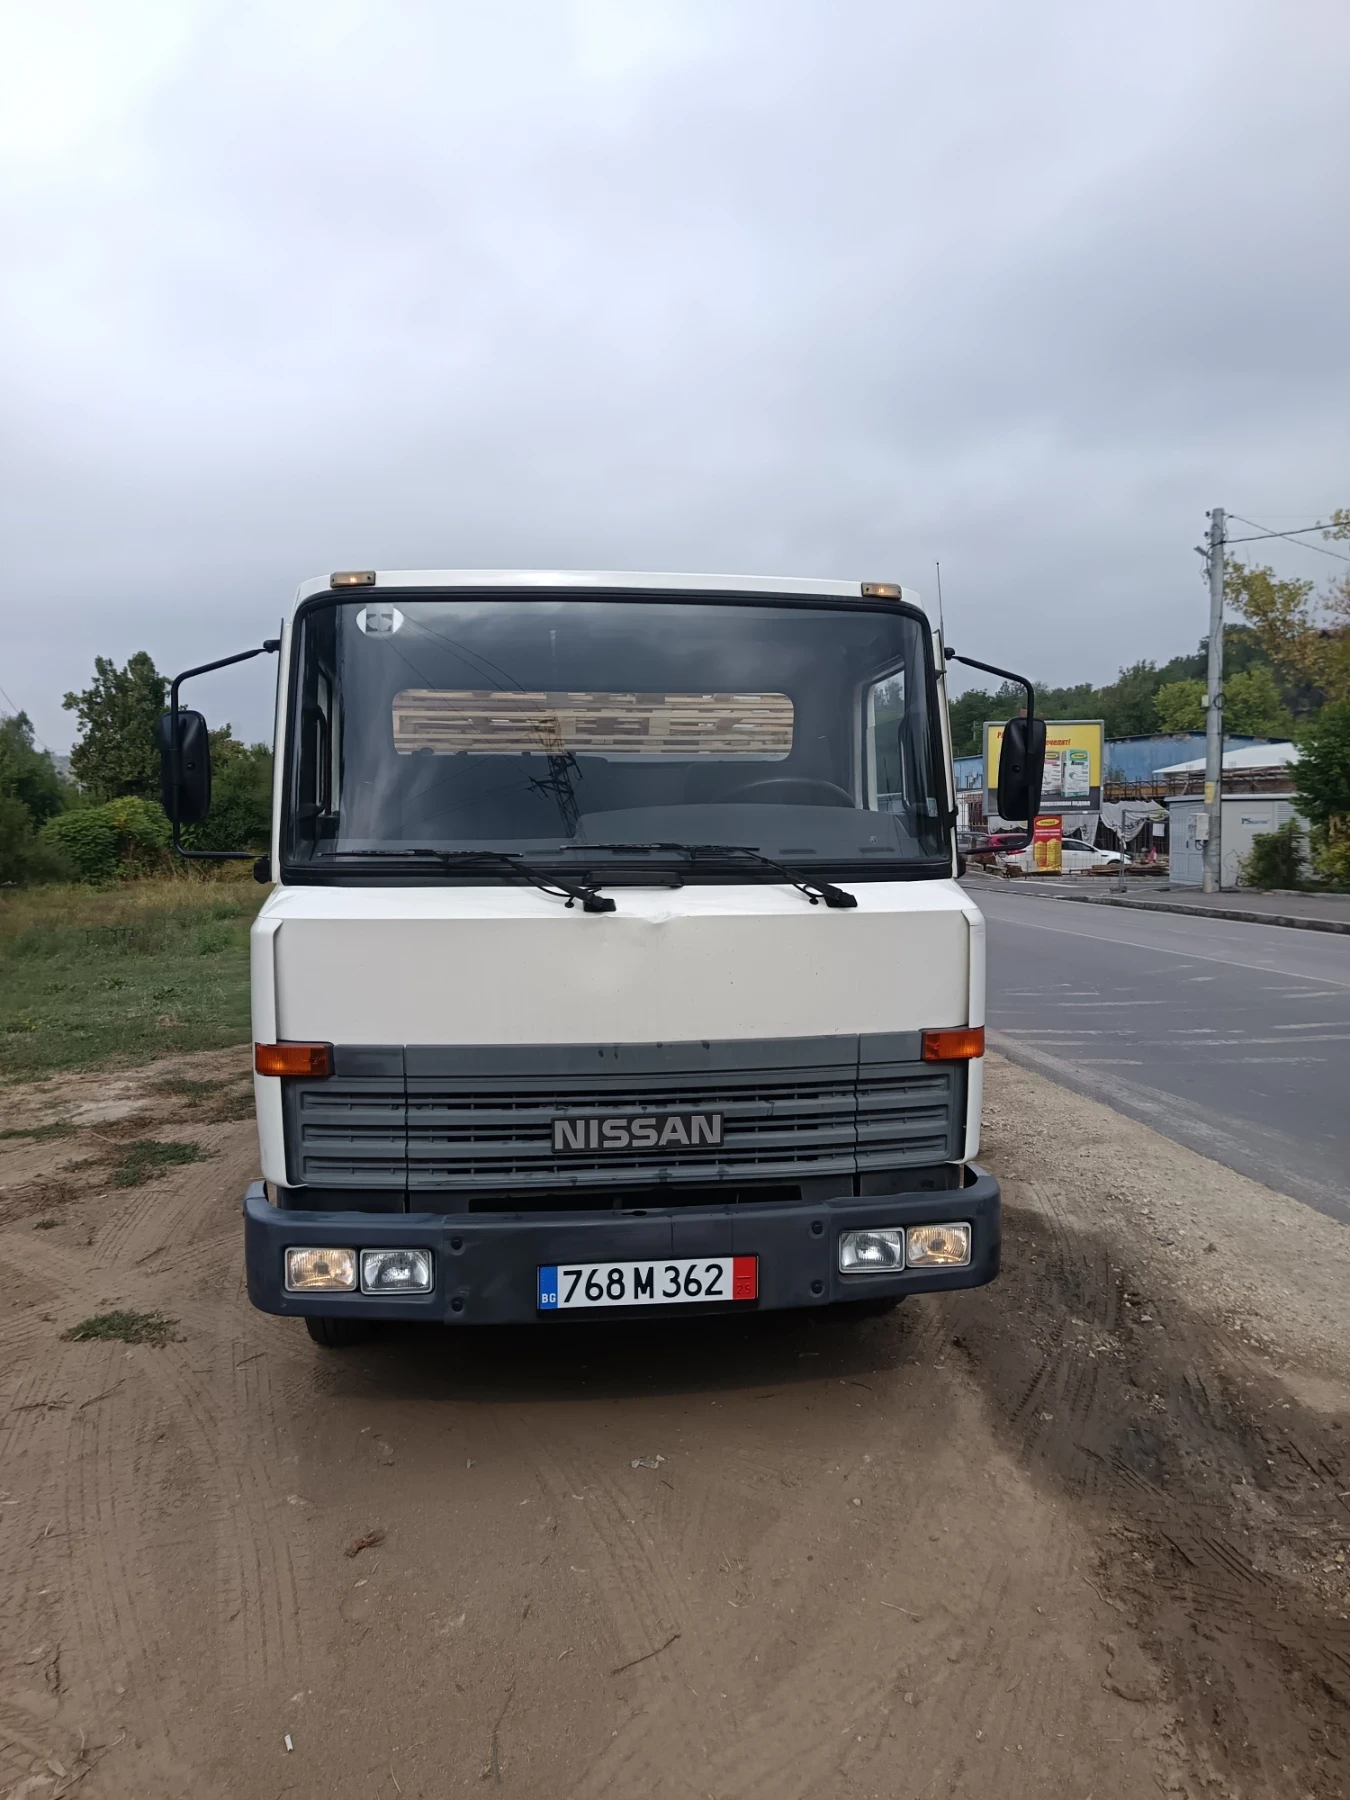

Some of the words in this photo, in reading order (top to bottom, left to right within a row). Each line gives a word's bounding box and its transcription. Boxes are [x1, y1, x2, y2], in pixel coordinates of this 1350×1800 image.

[554, 1114, 721, 1150] NISSAN
[563, 1267, 625, 1304] 768
[634, 1266, 655, 1300] M
[662, 1263, 724, 1298] 362
[736, 1281, 751, 1294] 25
[541, 1292, 556, 1304] BG
